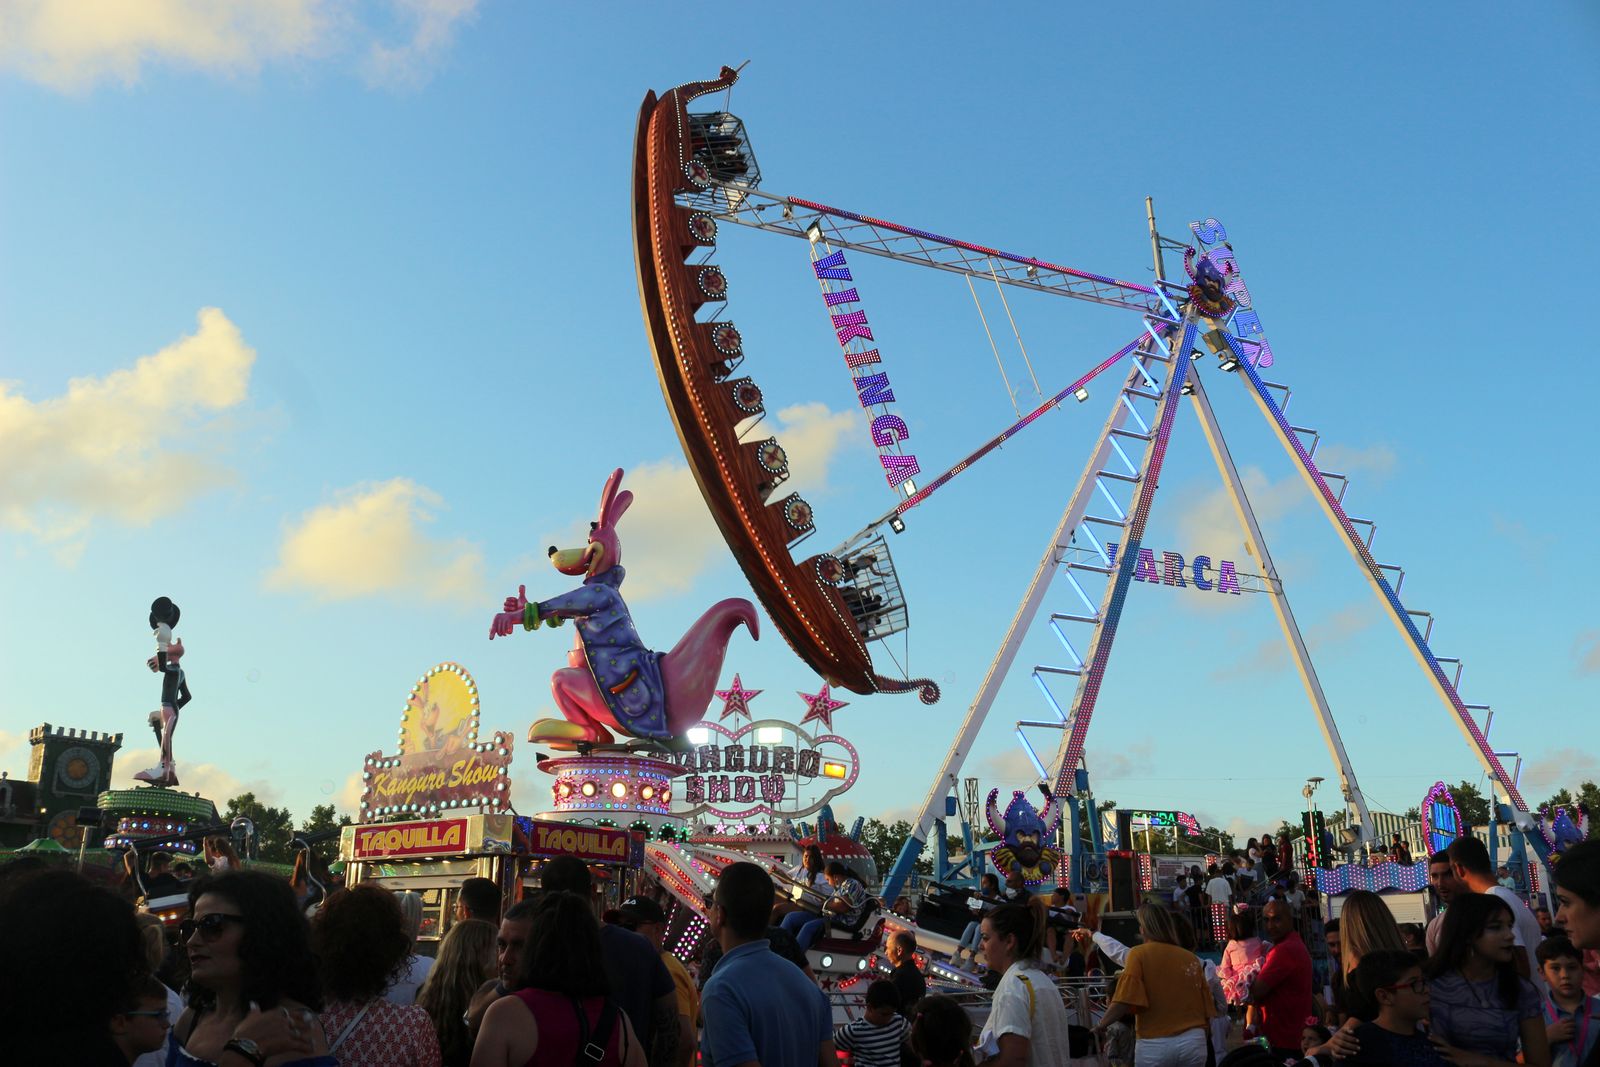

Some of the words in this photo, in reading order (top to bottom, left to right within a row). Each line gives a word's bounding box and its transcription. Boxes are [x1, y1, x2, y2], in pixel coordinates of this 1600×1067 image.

[1190, 218, 1274, 368] SUPER
[813, 250, 921, 488] VIKINGA
[647, 745, 821, 778] ANGURO
[374, 764, 445, 806] Kanguro
[447, 756, 499, 788] Show
[686, 775, 786, 803] SHOW
[360, 824, 460, 854] TAQUILLA
[538, 826, 626, 857] TAQUILLA
